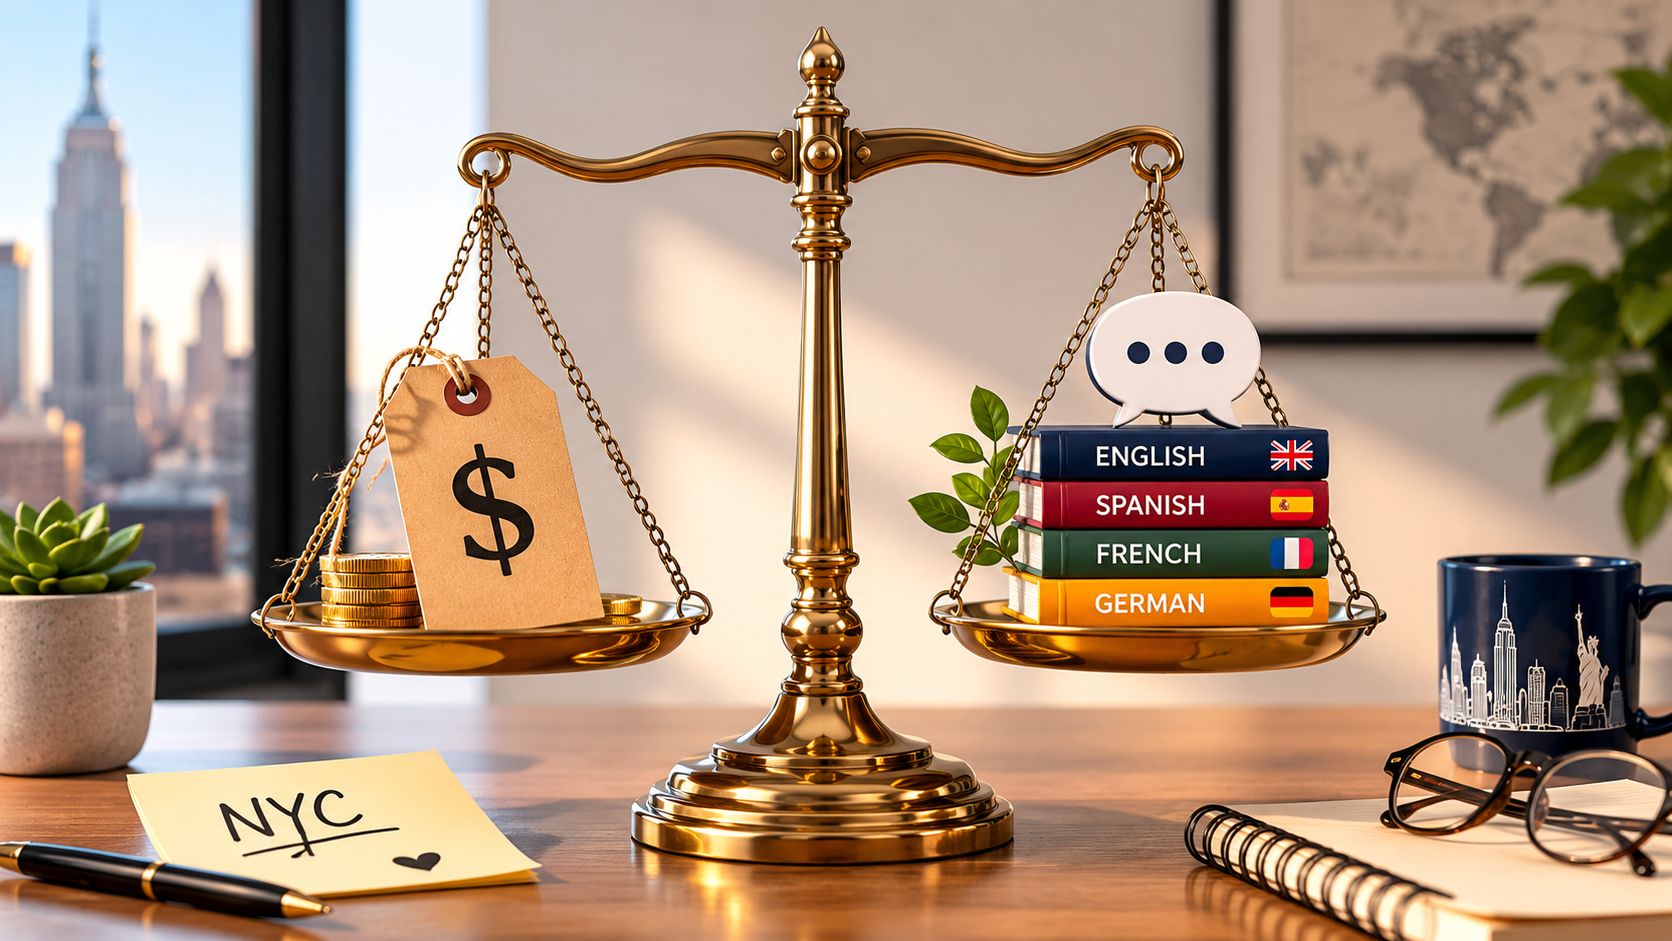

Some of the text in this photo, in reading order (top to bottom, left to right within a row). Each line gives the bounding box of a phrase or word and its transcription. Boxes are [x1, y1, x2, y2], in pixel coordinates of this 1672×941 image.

[1096, 445, 1206, 468] ENGLISH
[452, 443, 535, 577] $
[1096, 494, 1206, 516] SPANISH
[1096, 543, 1202, 565] FRENCH
[1095, 593, 1206, 614] GERMAN
[218, 789, 363, 858] NYC
